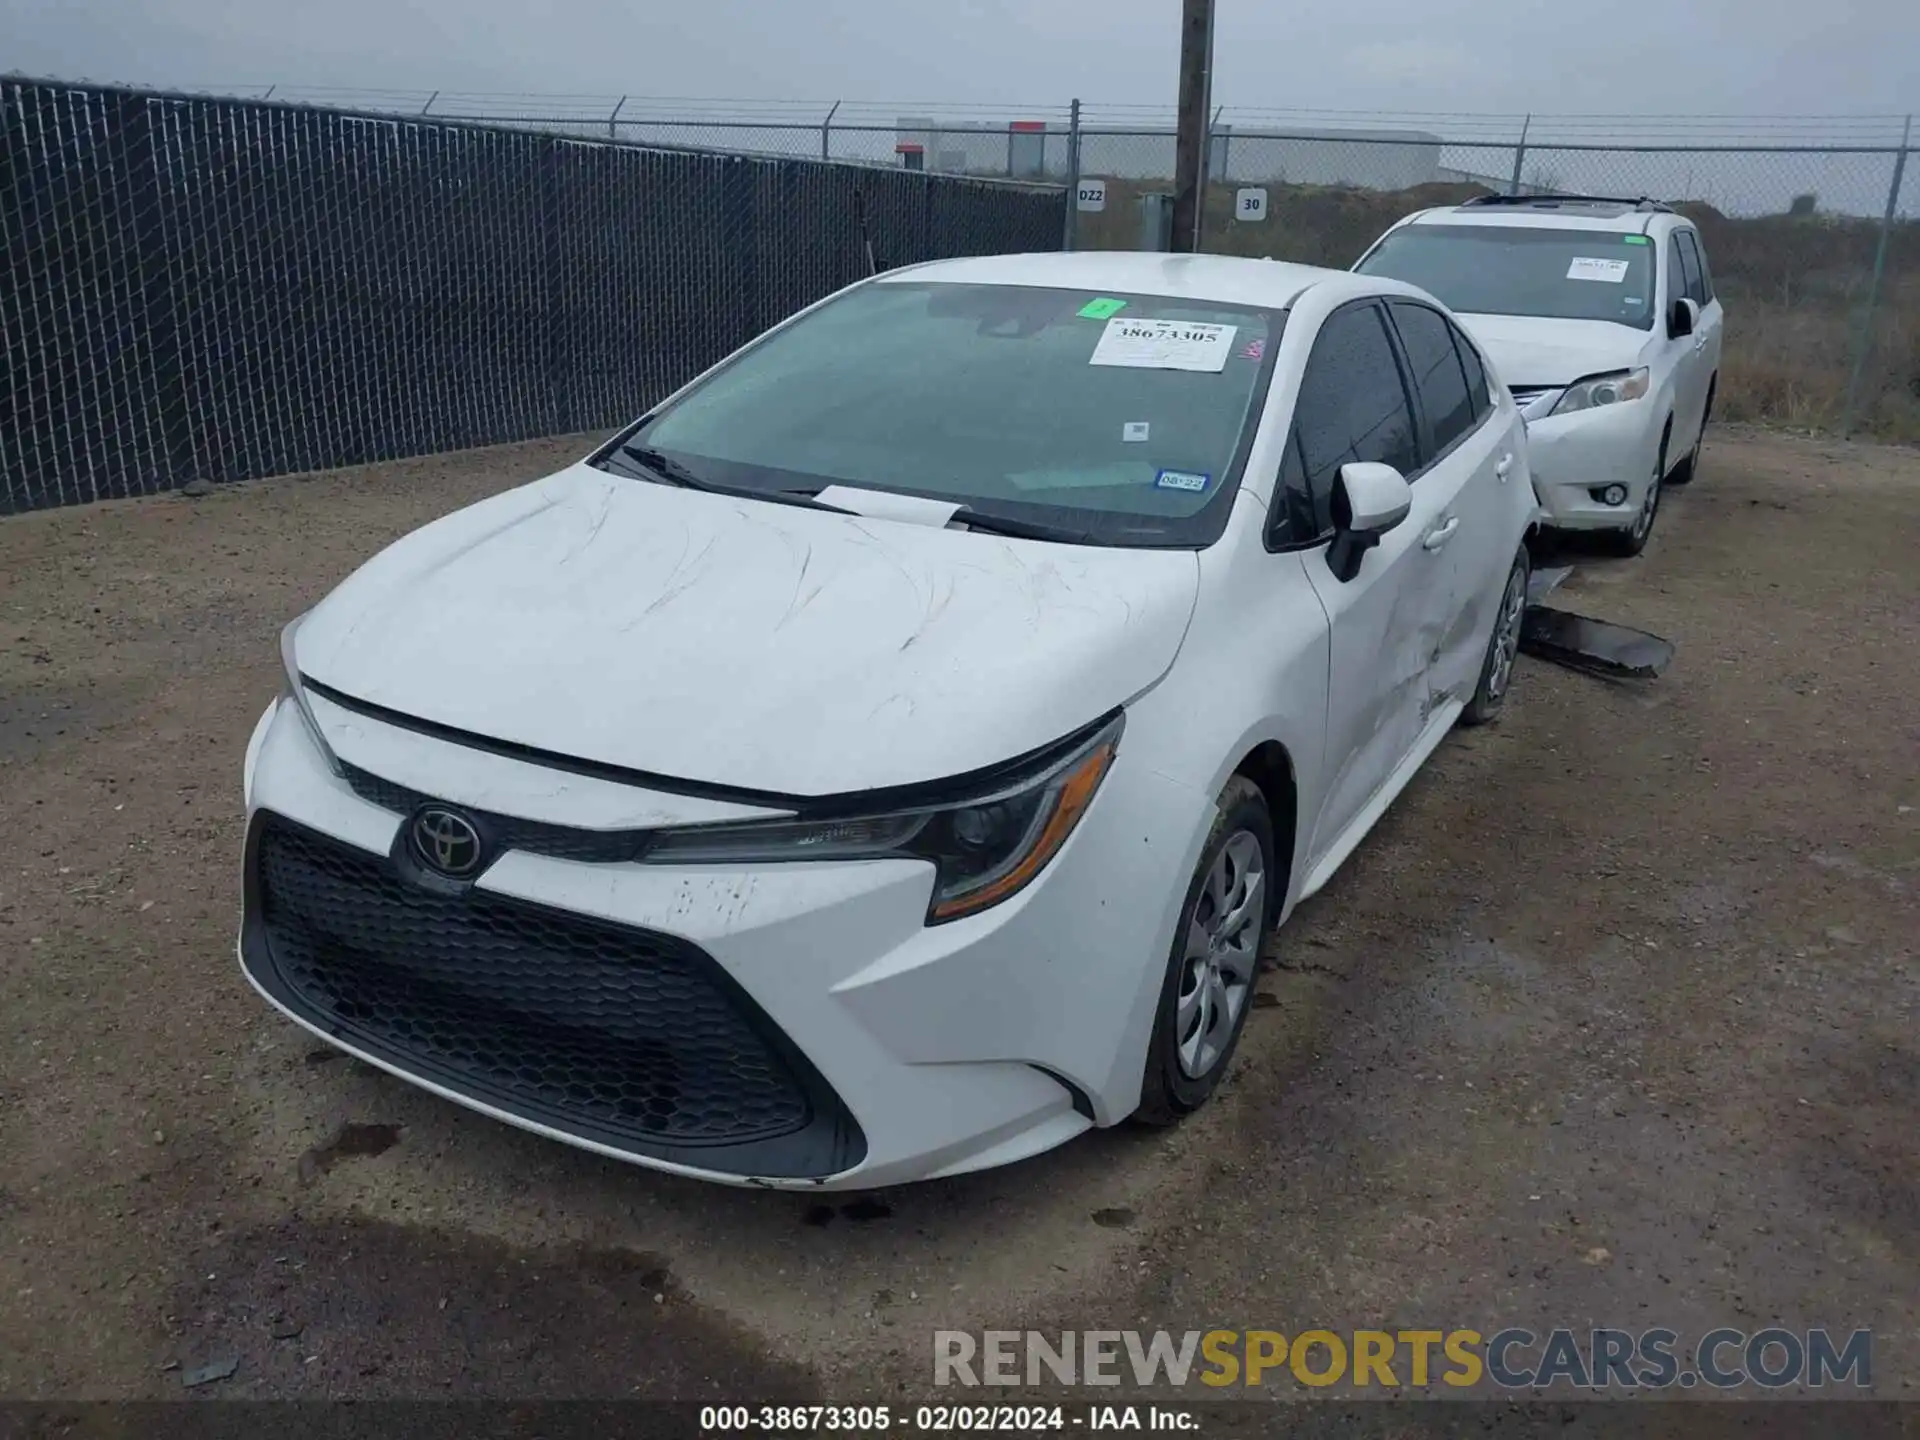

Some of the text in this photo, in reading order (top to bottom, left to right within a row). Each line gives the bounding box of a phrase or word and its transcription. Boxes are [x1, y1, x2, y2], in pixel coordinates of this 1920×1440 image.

[1079, 190, 1102, 201] DZ2
[1244, 199, 1259, 210] 30
[1117, 328, 1217, 344] 38673305
